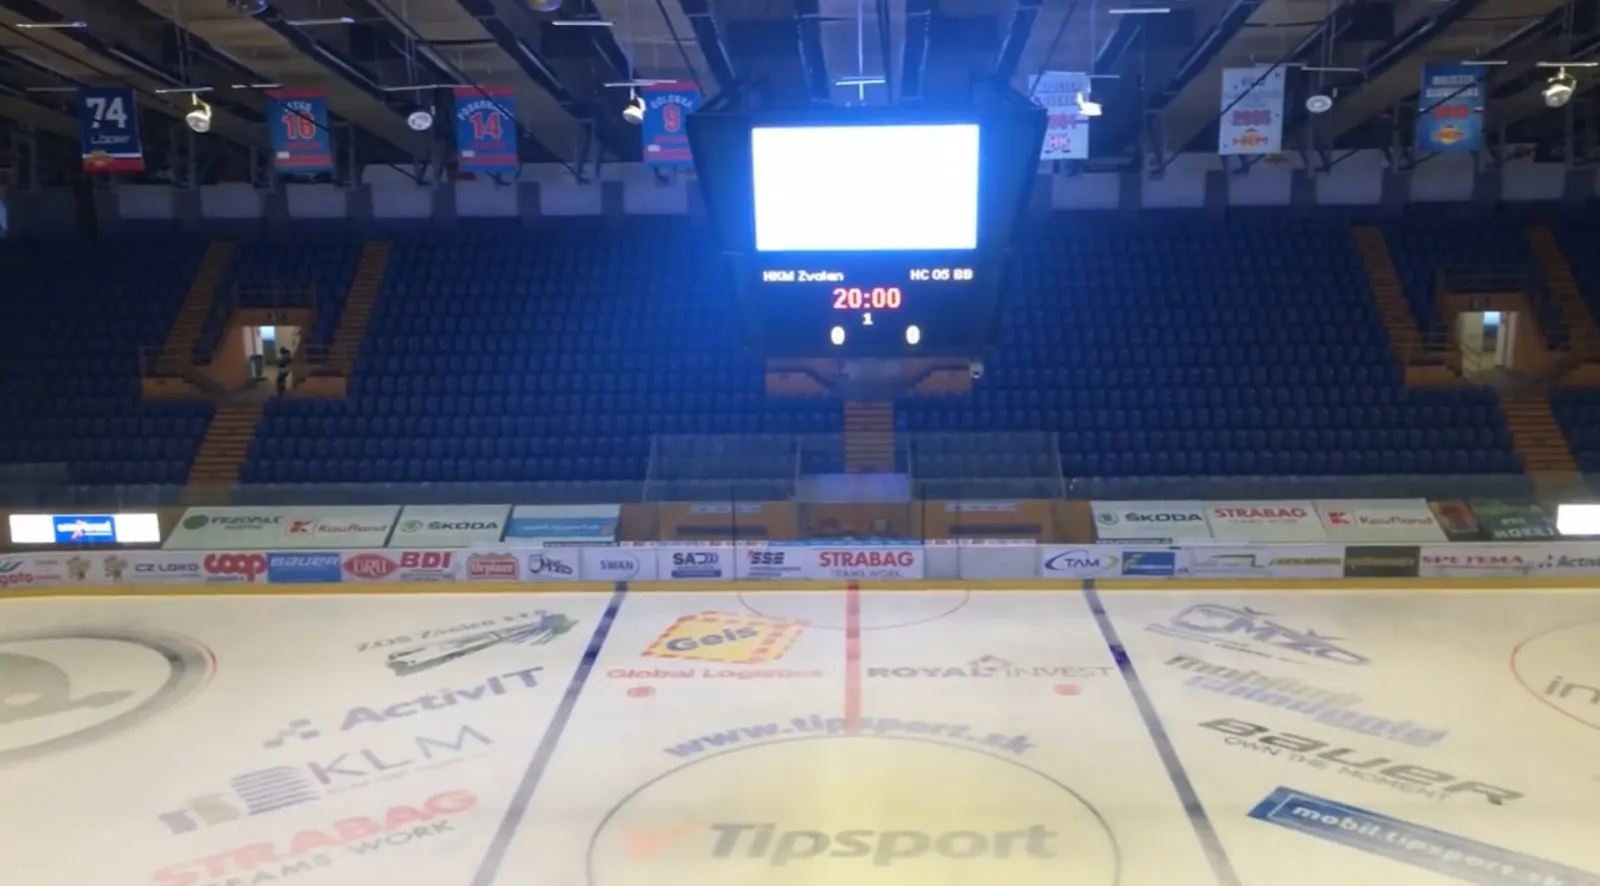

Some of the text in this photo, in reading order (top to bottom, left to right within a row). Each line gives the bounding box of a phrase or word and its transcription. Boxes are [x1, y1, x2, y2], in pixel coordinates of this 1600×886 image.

[85, 96, 128, 129] 74
[662, 103, 681, 132] 9
[281, 111, 316, 139] 16
[468, 111, 503, 140] 14
[763, 270, 844, 282] HKM Zvolen
[910, 268, 973, 280] HC 05 BB
[833, 287, 901, 309] 20:00
[862, 312, 873, 326] 1
[830, 325, 845, 346] 0
[906, 324, 921, 345] 0
[1214, 507, 1307, 519] STRABAG
[317, 523, 388, 534] Kaufland
[400, 551, 452, 569] BDI
[600, 559, 634, 571] SWAN
[819, 551, 914, 567] STRABAG
[1065, 558, 1100, 568] TAM
[666, 626, 760, 652] Geis
[606, 668, 824, 681] Global Logistics
[340, 666, 544, 732] ActivIT
[664, 714, 1036, 757] www.tipsport.sk
[1223, 735, 1281, 757] OWN
[307, 724, 494, 786] KLM
[151, 789, 479, 886] STRABAG
[346, 819, 455, 855] WORK
[709, 823, 1058, 867] Tipsport
